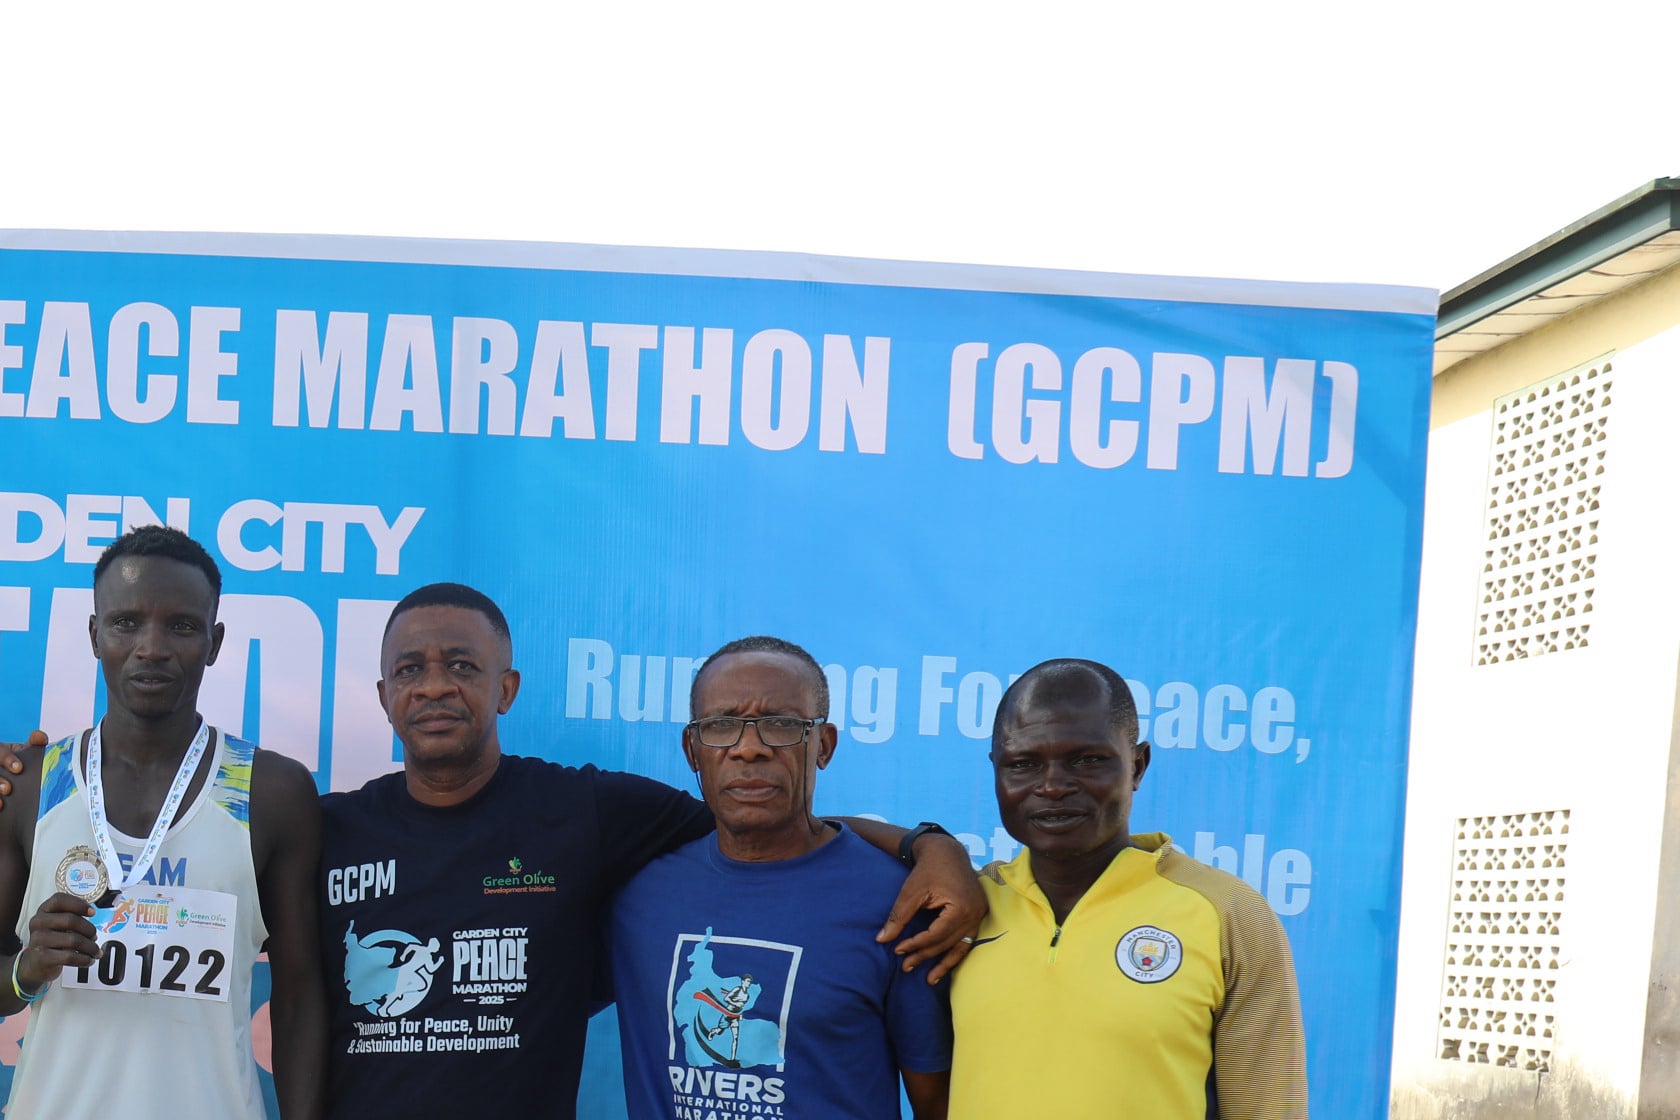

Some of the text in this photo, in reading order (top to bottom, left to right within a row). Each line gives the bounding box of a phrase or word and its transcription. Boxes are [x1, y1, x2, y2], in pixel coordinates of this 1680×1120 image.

[272, 309, 891, 455] MARATHON
[948, 340, 1359, 480] (GCPM)
[217, 498, 426, 576] CITY
[918, 655, 1017, 740] Fo
[1125, 677, 1311, 764] eace,
[97, 850, 187, 887] EAM
[328, 859, 396, 906] GCPM
[482, 872, 555, 887] Green Olive
[483, 885, 556, 895] Development Initiative
[136, 903, 168, 925] PEACE
[190, 912, 209, 920] Green
[452, 927, 528, 940] GARDEN CITY
[1126, 929, 1176, 950] MANCHESTER
[452, 938, 529, 982] PEACE
[452, 982, 527, 994] MARATHON
[478, 995, 504, 1005] 2025
[400, 1017, 421, 1034] for
[424, 1017, 473, 1034] Peace,
[477, 1014, 513, 1033] Unity
[347, 1033, 520, 1054] & Sustainable Development
[668, 1065, 786, 1104] RIVERS
[673, 1094, 784, 1116] INTERNATIONAL
